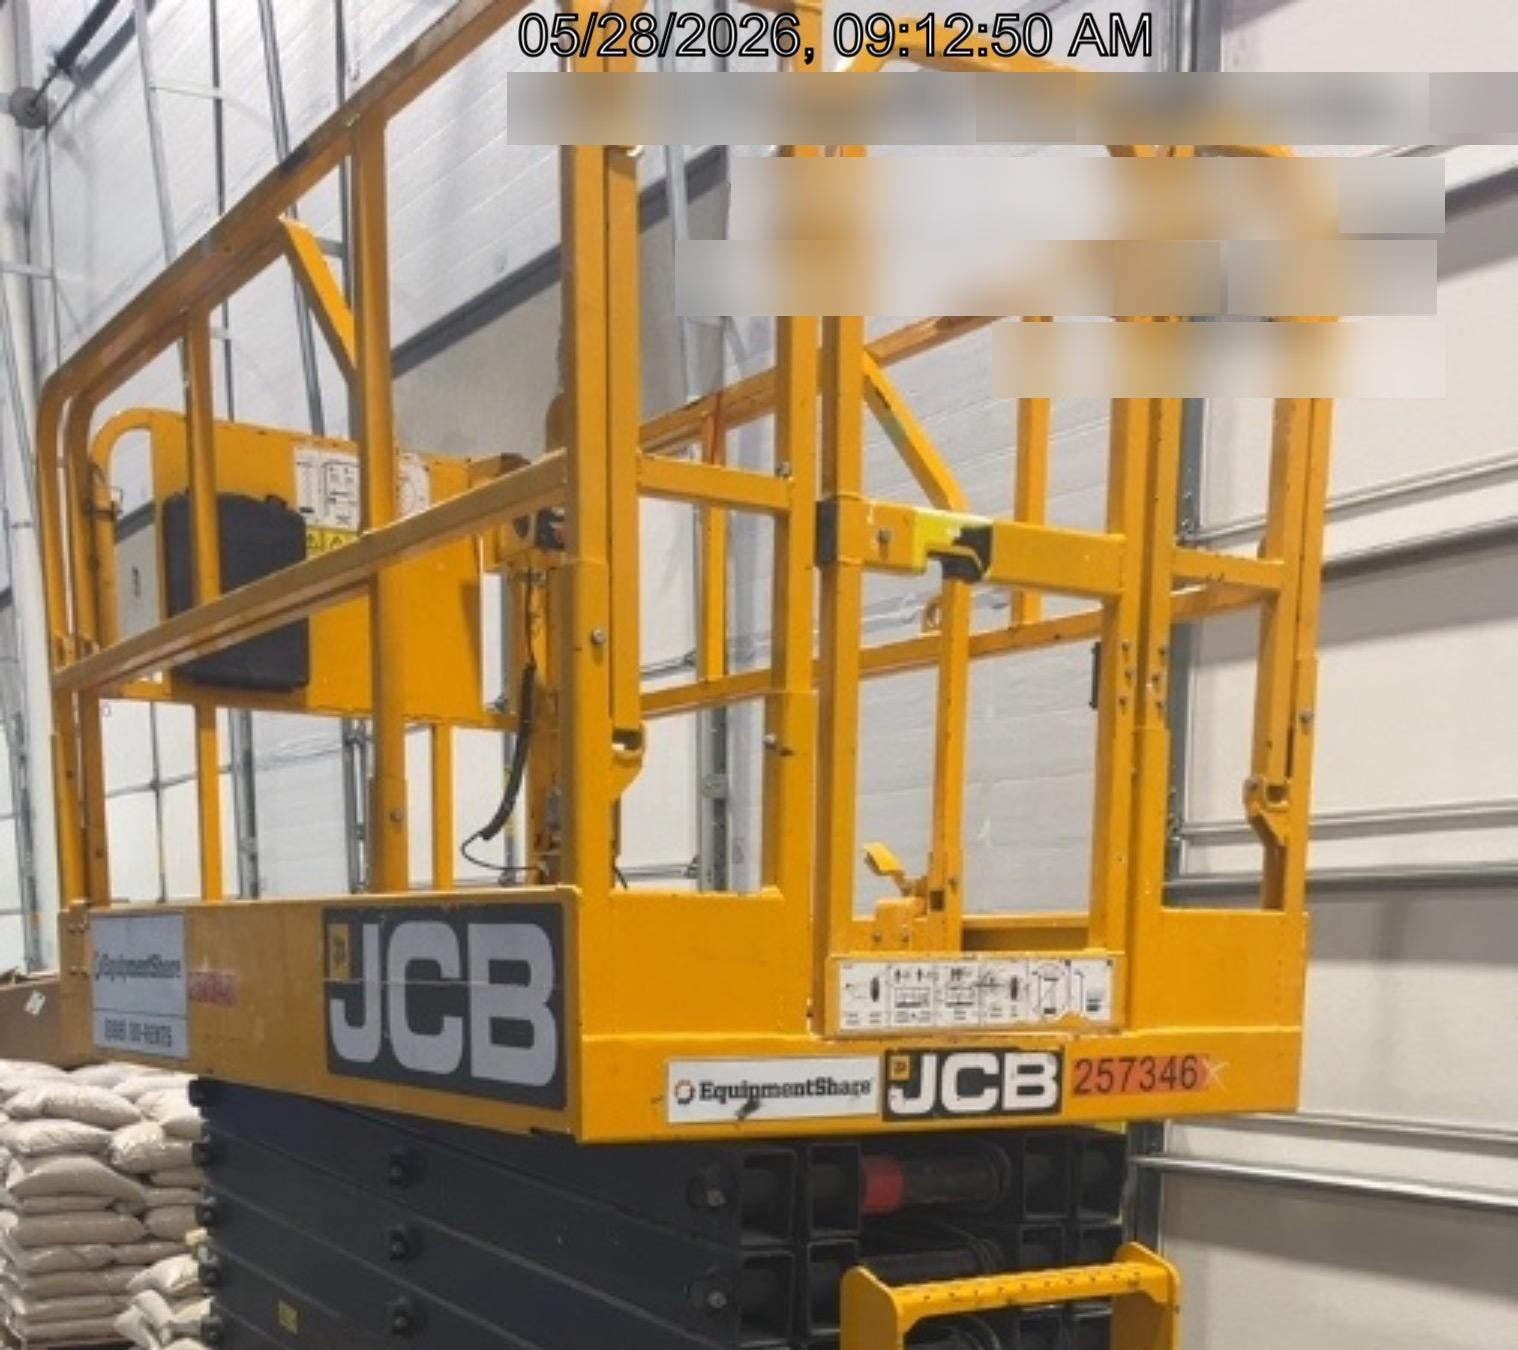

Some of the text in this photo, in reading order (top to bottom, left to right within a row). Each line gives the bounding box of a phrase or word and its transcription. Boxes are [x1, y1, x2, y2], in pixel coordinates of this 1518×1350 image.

[330, 920, 557, 1086] JCB
[698, 1076, 872, 1107] EquipmentShare
[889, 1051, 1059, 1116] JCB
[1073, 1054, 1198, 1096] 257346
